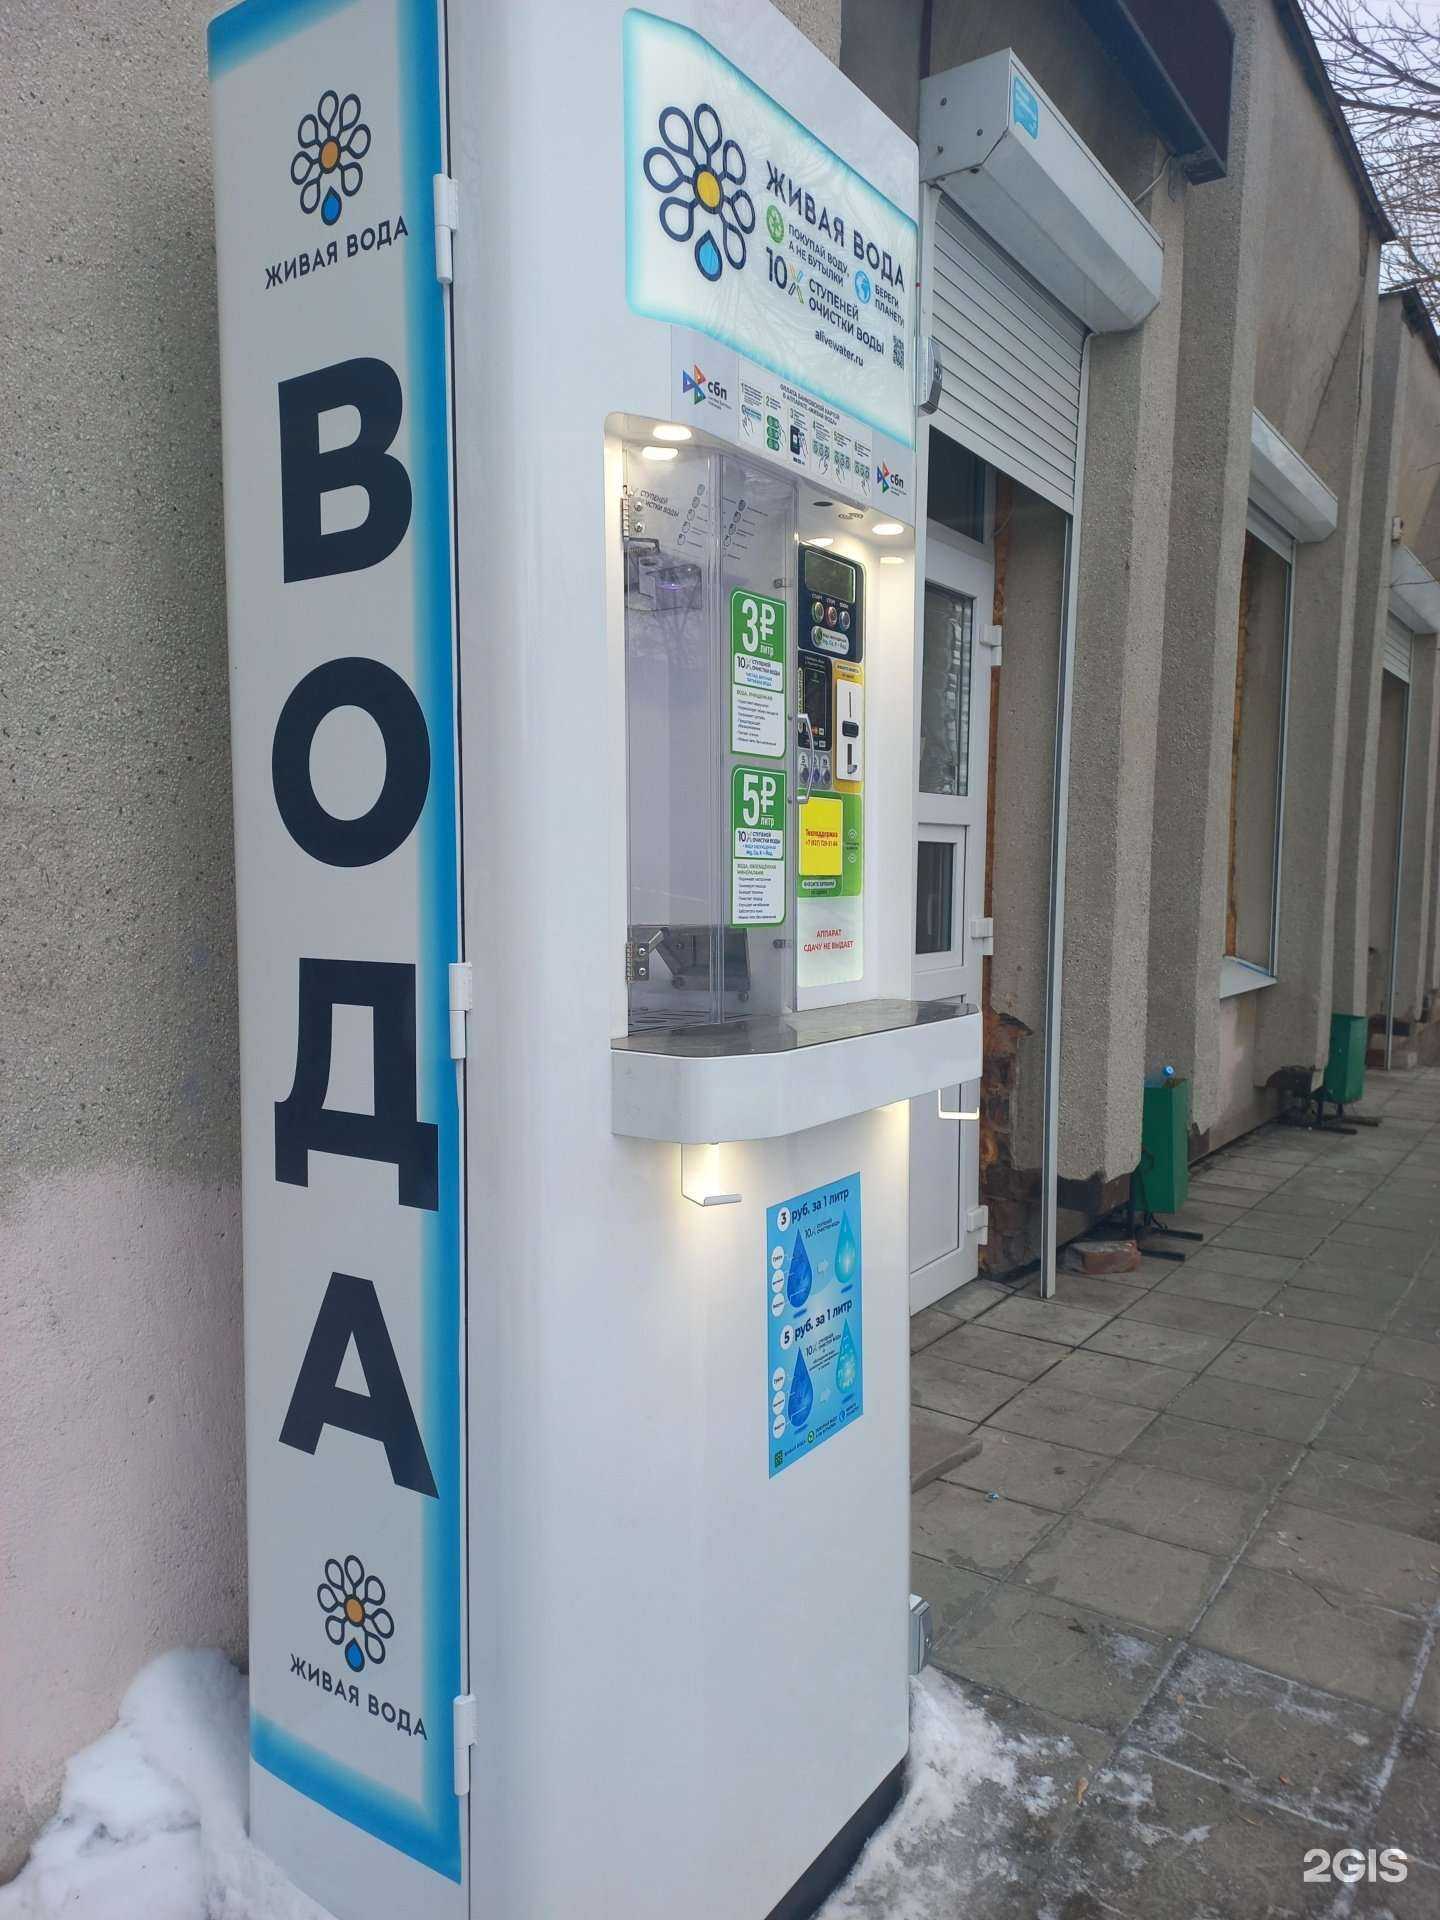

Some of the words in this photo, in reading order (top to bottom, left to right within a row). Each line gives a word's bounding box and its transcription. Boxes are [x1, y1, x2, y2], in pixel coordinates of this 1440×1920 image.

[766, 160, 844, 248] ЖИВАЯ
[853, 229, 905, 294] ВОДА
[788, 223, 826, 259] ПОКУПАЙ
[264, 240, 338, 290] ЖИВАЯ
[346, 215, 409, 258] ВОДА
[766, 246, 788, 290] 10
[788, 241, 795, 254] А
[796, 245, 807, 262] НЕ
[807, 252, 844, 288] БУТЫЛКИ
[809, 278, 859, 321] СТУПЕНЕЙ
[875, 284, 899, 309] БЕРЕГИ
[808, 297, 854, 336] ОЧИСТКИ
[856, 326, 885, 355] ВОДЫ
[815, 329, 864, 367] alivewater.ru
[736, 655, 746, 669] 10
[737, 830, 747, 842] 10
[271, 357, 441, 1501] ВОДА
[803, 943, 823, 952] СДАЧУ
[823, 942, 831, 950] НЕ
[816, 929, 842, 938] АППАРАТ
[780, 1211, 787, 1226] 3
[791, 1202, 810, 1224] руб.
[812, 1200, 822, 1212] за
[829, 1188, 849, 1207] литр
[784, 1330, 790, 1345] 5
[794, 1317, 813, 1342] руб.
[815, 1314, 825, 1327] за
[832, 1299, 853, 1318] литр
[290, 1653, 360, 1707] ЖИВАЯ
[367, 1693, 428, 1741] ВОДА
